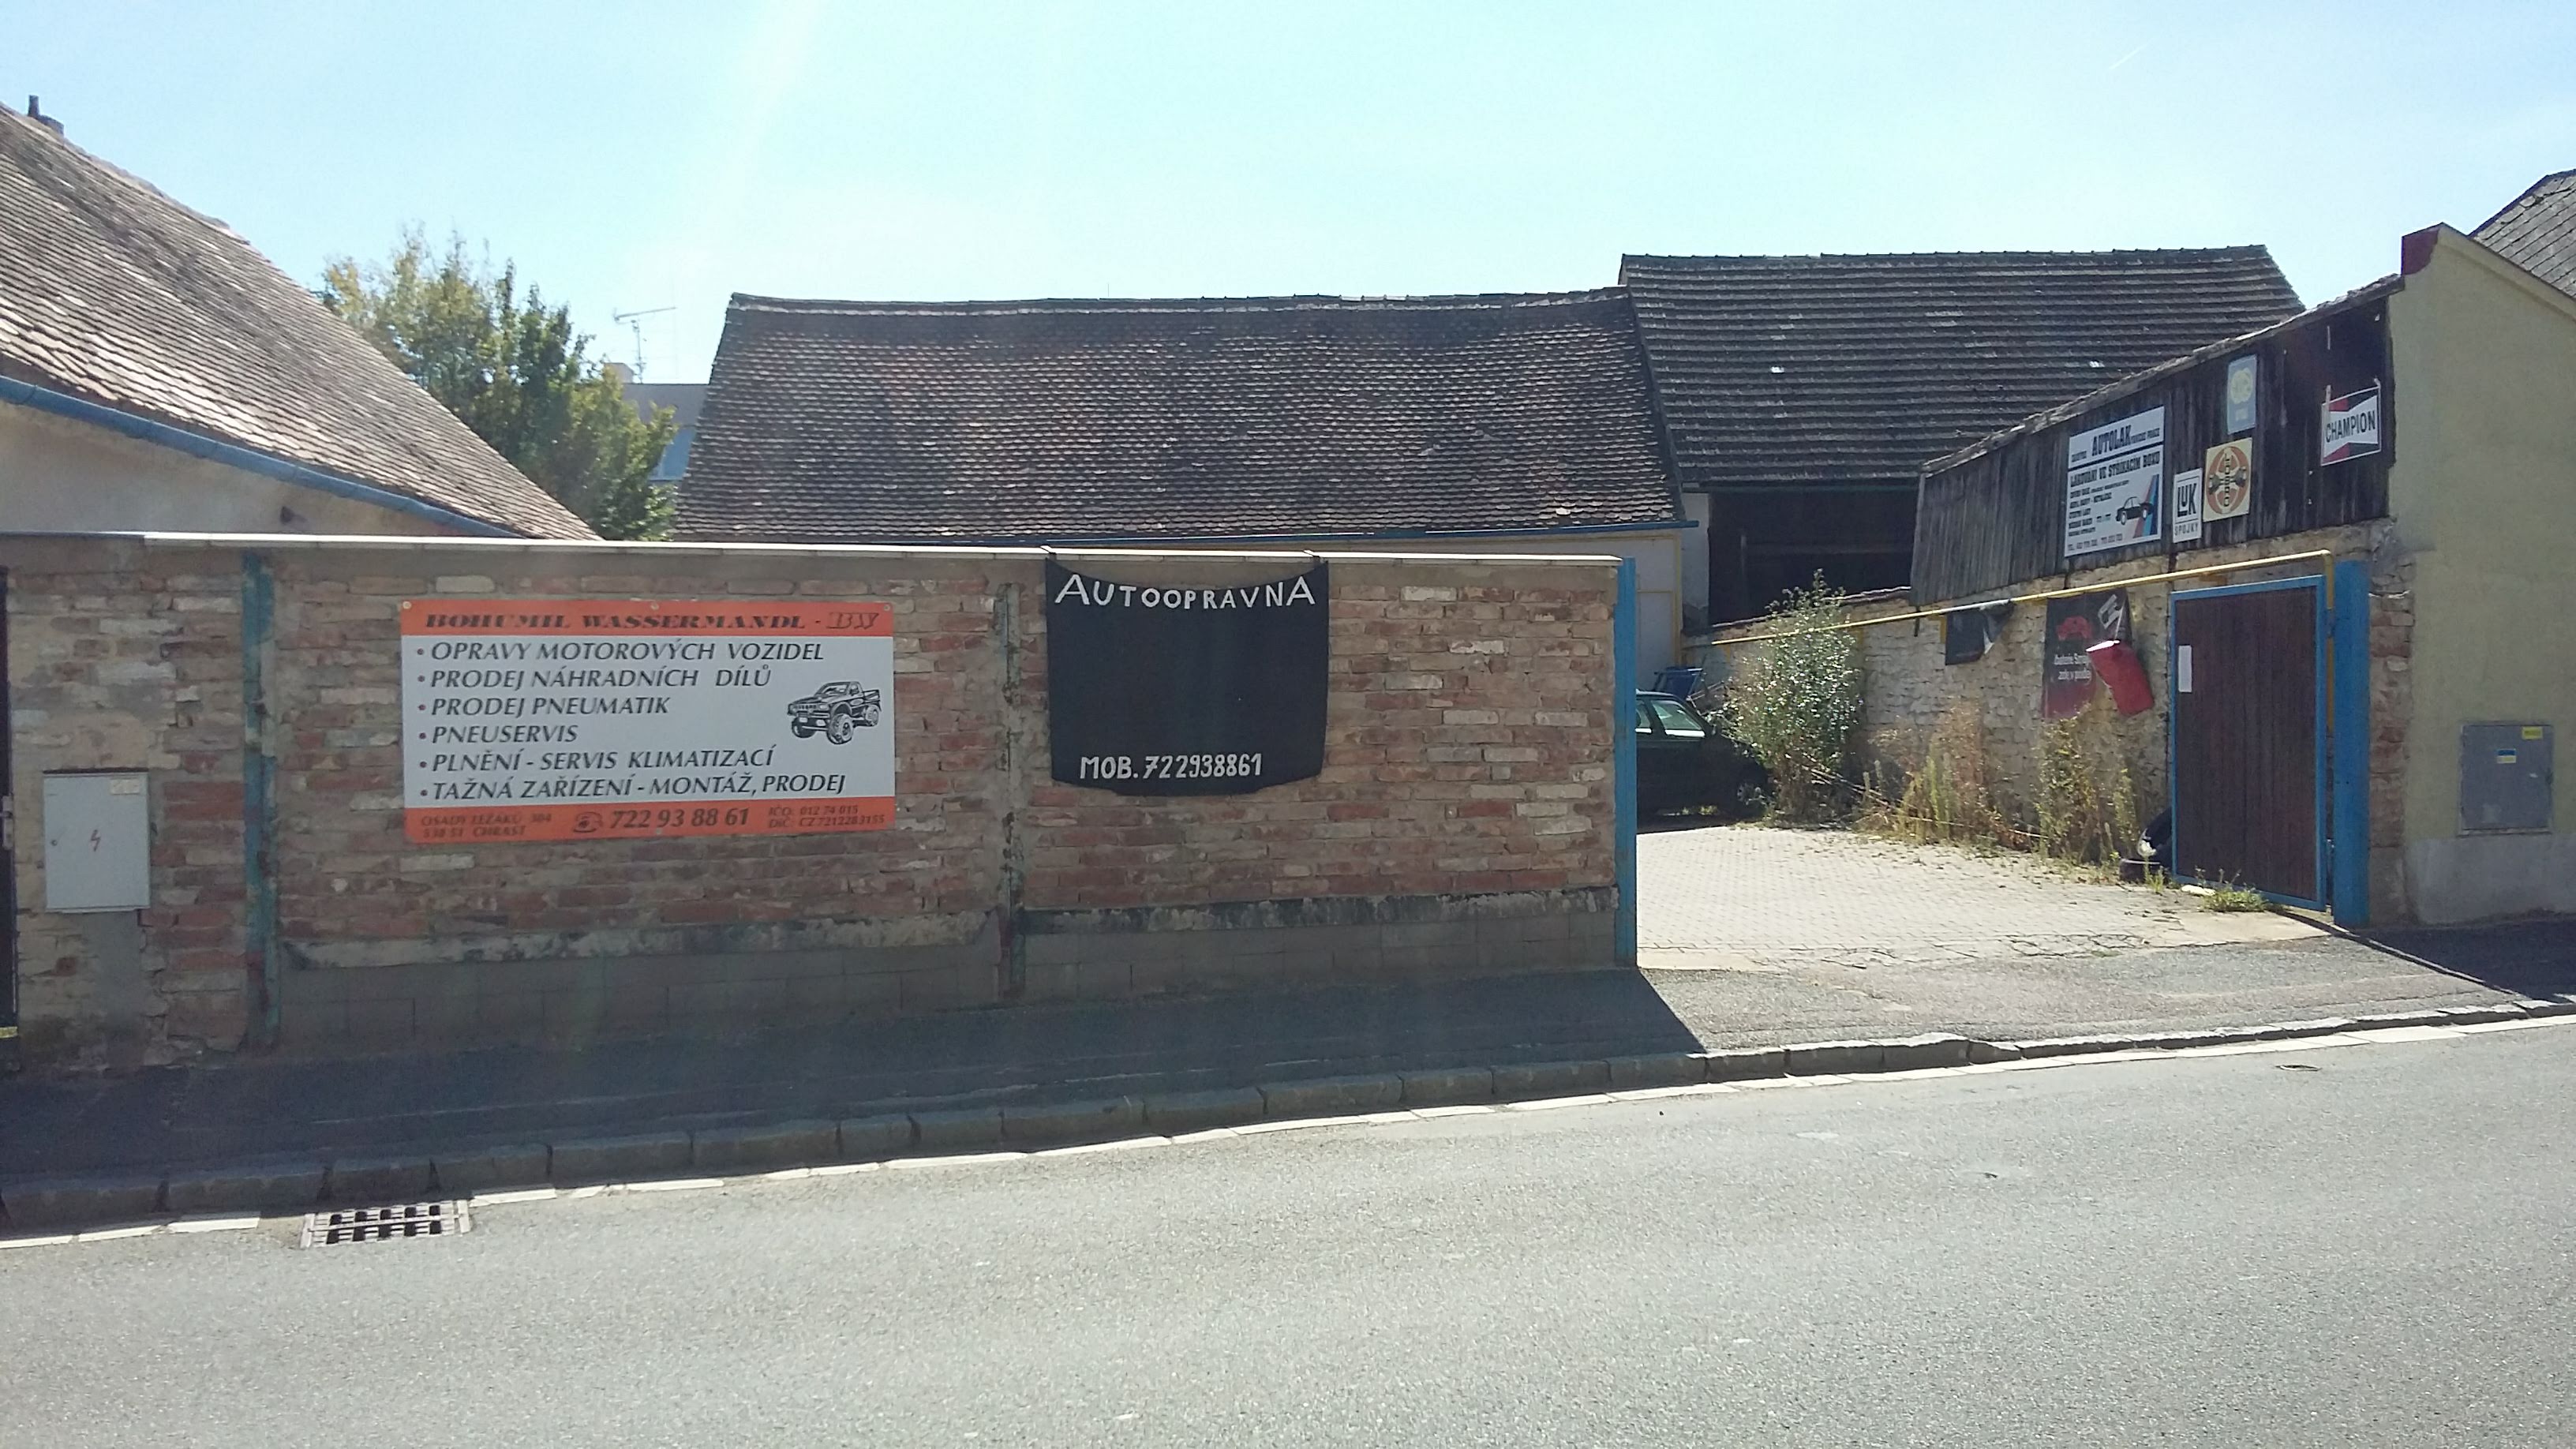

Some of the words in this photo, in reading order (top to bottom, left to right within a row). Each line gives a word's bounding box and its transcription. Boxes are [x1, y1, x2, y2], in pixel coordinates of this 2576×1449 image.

[2326, 410, 2376, 443] CHAMPION
[2091, 424, 2132, 456] AUTOLAK
[2174, 522, 2198, 536] SPOJKY
[1054, 574, 1316, 609] AUTOOPRAVNA
[425, 614, 571, 628] BOHUMIL
[582, 615, 806, 630] WASSERMANDL
[431, 642, 531, 660] OPRAVY
[536, 638, 716, 660] MOTOROVÝCH
[728, 643, 824, 660] VOZIDEL
[431, 669, 530, 691] PRODEJ
[532, 665, 699, 687] NÁHRADNÍCH
[715, 665, 772, 687] DÍLŮ
[431, 697, 526, 719] PRODEJ
[531, 697, 671, 715] PNEUMATIK
[432, 724, 578, 743] PNEUSERVIS
[432, 748, 525, 771] PLNĚNÍ
[540, 751, 619, 770] SERVIS
[628, 744, 777, 768] KLIMATIZACÍ
[432, 776, 515, 800] TAŽNÁ
[520, 773, 636, 799] ZAŘÍZENÍ
[649, 770, 757, 796] MONTÁŽ,
[762, 774, 846, 795] PRODEJ
[610, 810, 652, 829] 722
[657, 808, 686, 828] 93
[691, 808, 719, 827] 88
[724, 807, 750, 826] 61
